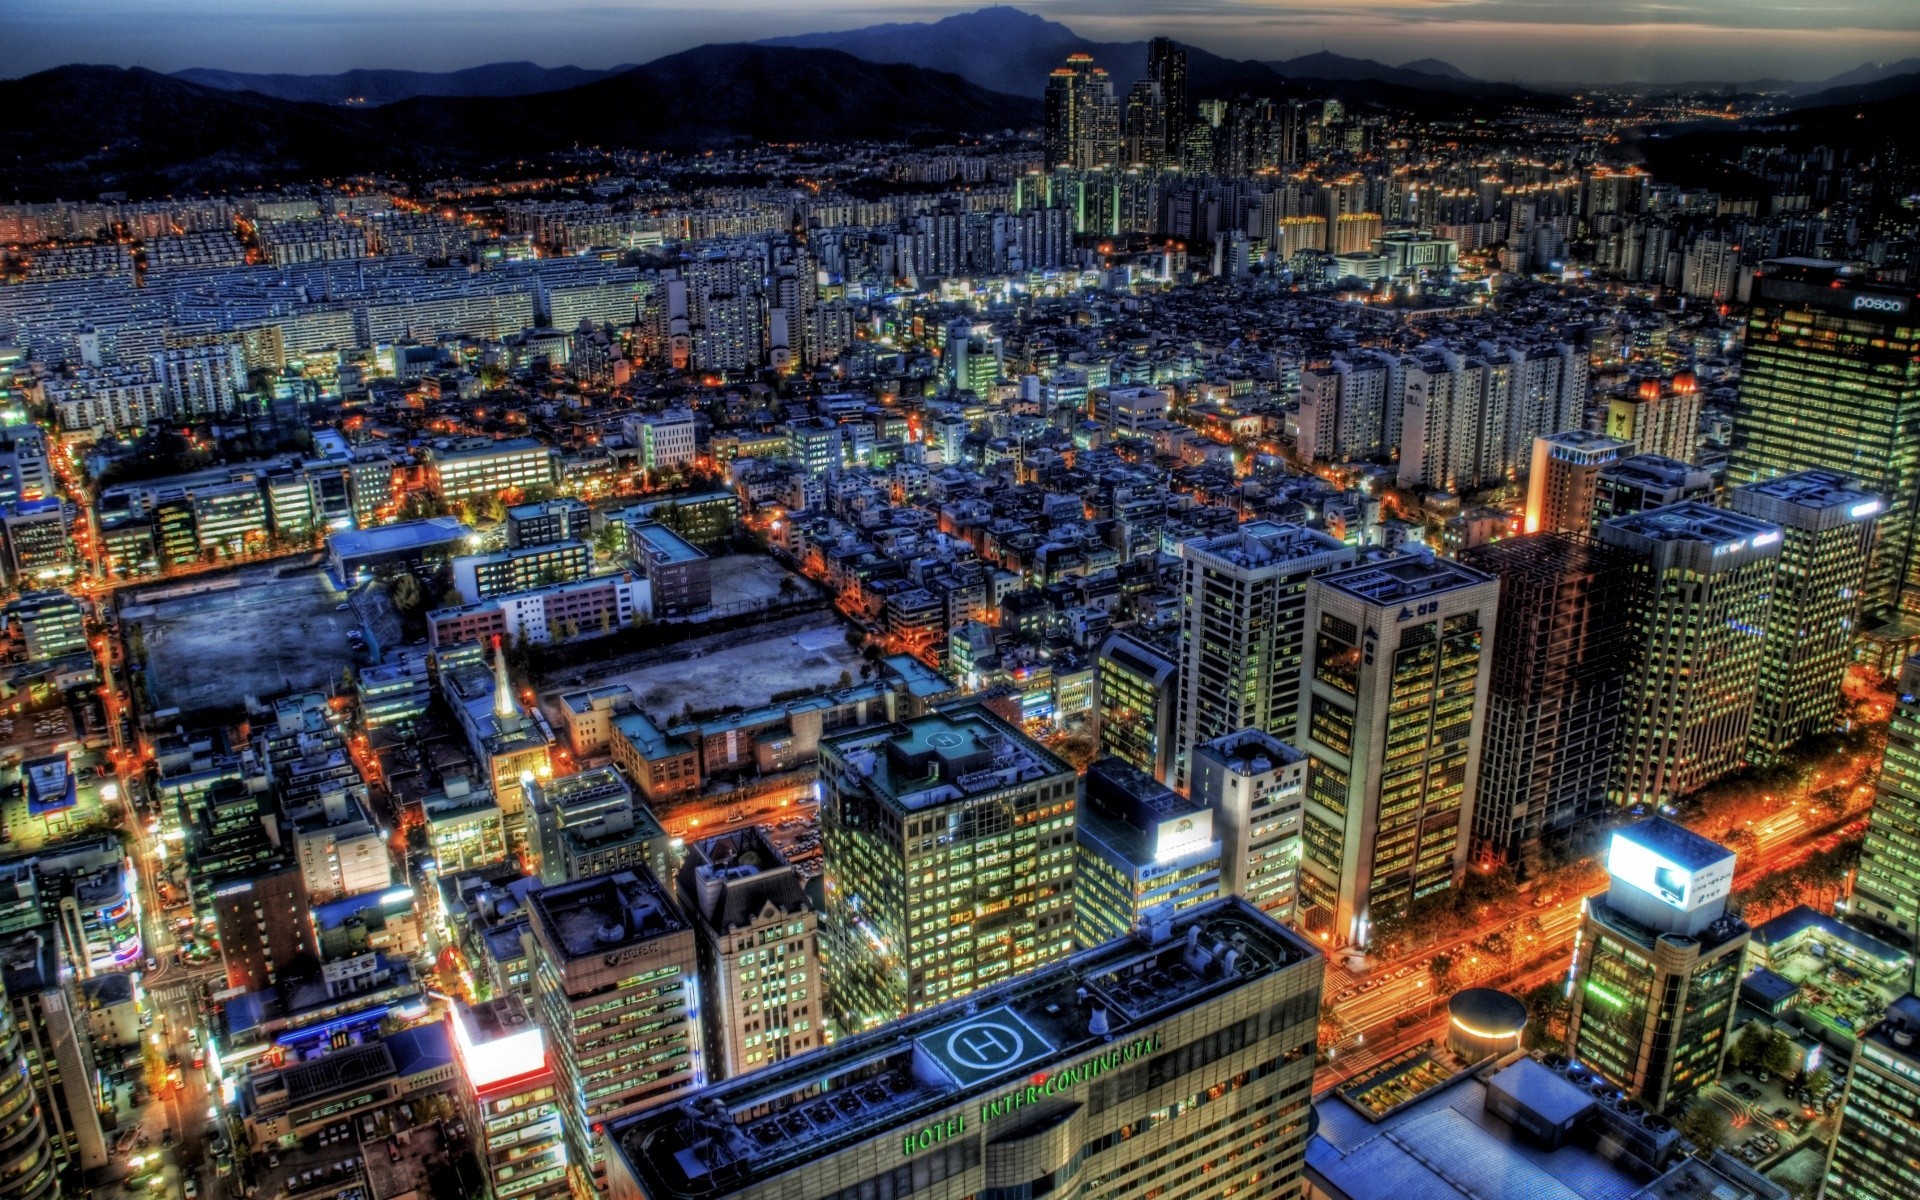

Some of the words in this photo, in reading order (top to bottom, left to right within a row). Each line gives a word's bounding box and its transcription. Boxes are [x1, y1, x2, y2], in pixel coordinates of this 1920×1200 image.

[1854, 296, 1901, 311] posco
[963, 1030, 1009, 1061] H
[903, 1115, 966, 1156] HOTEL
